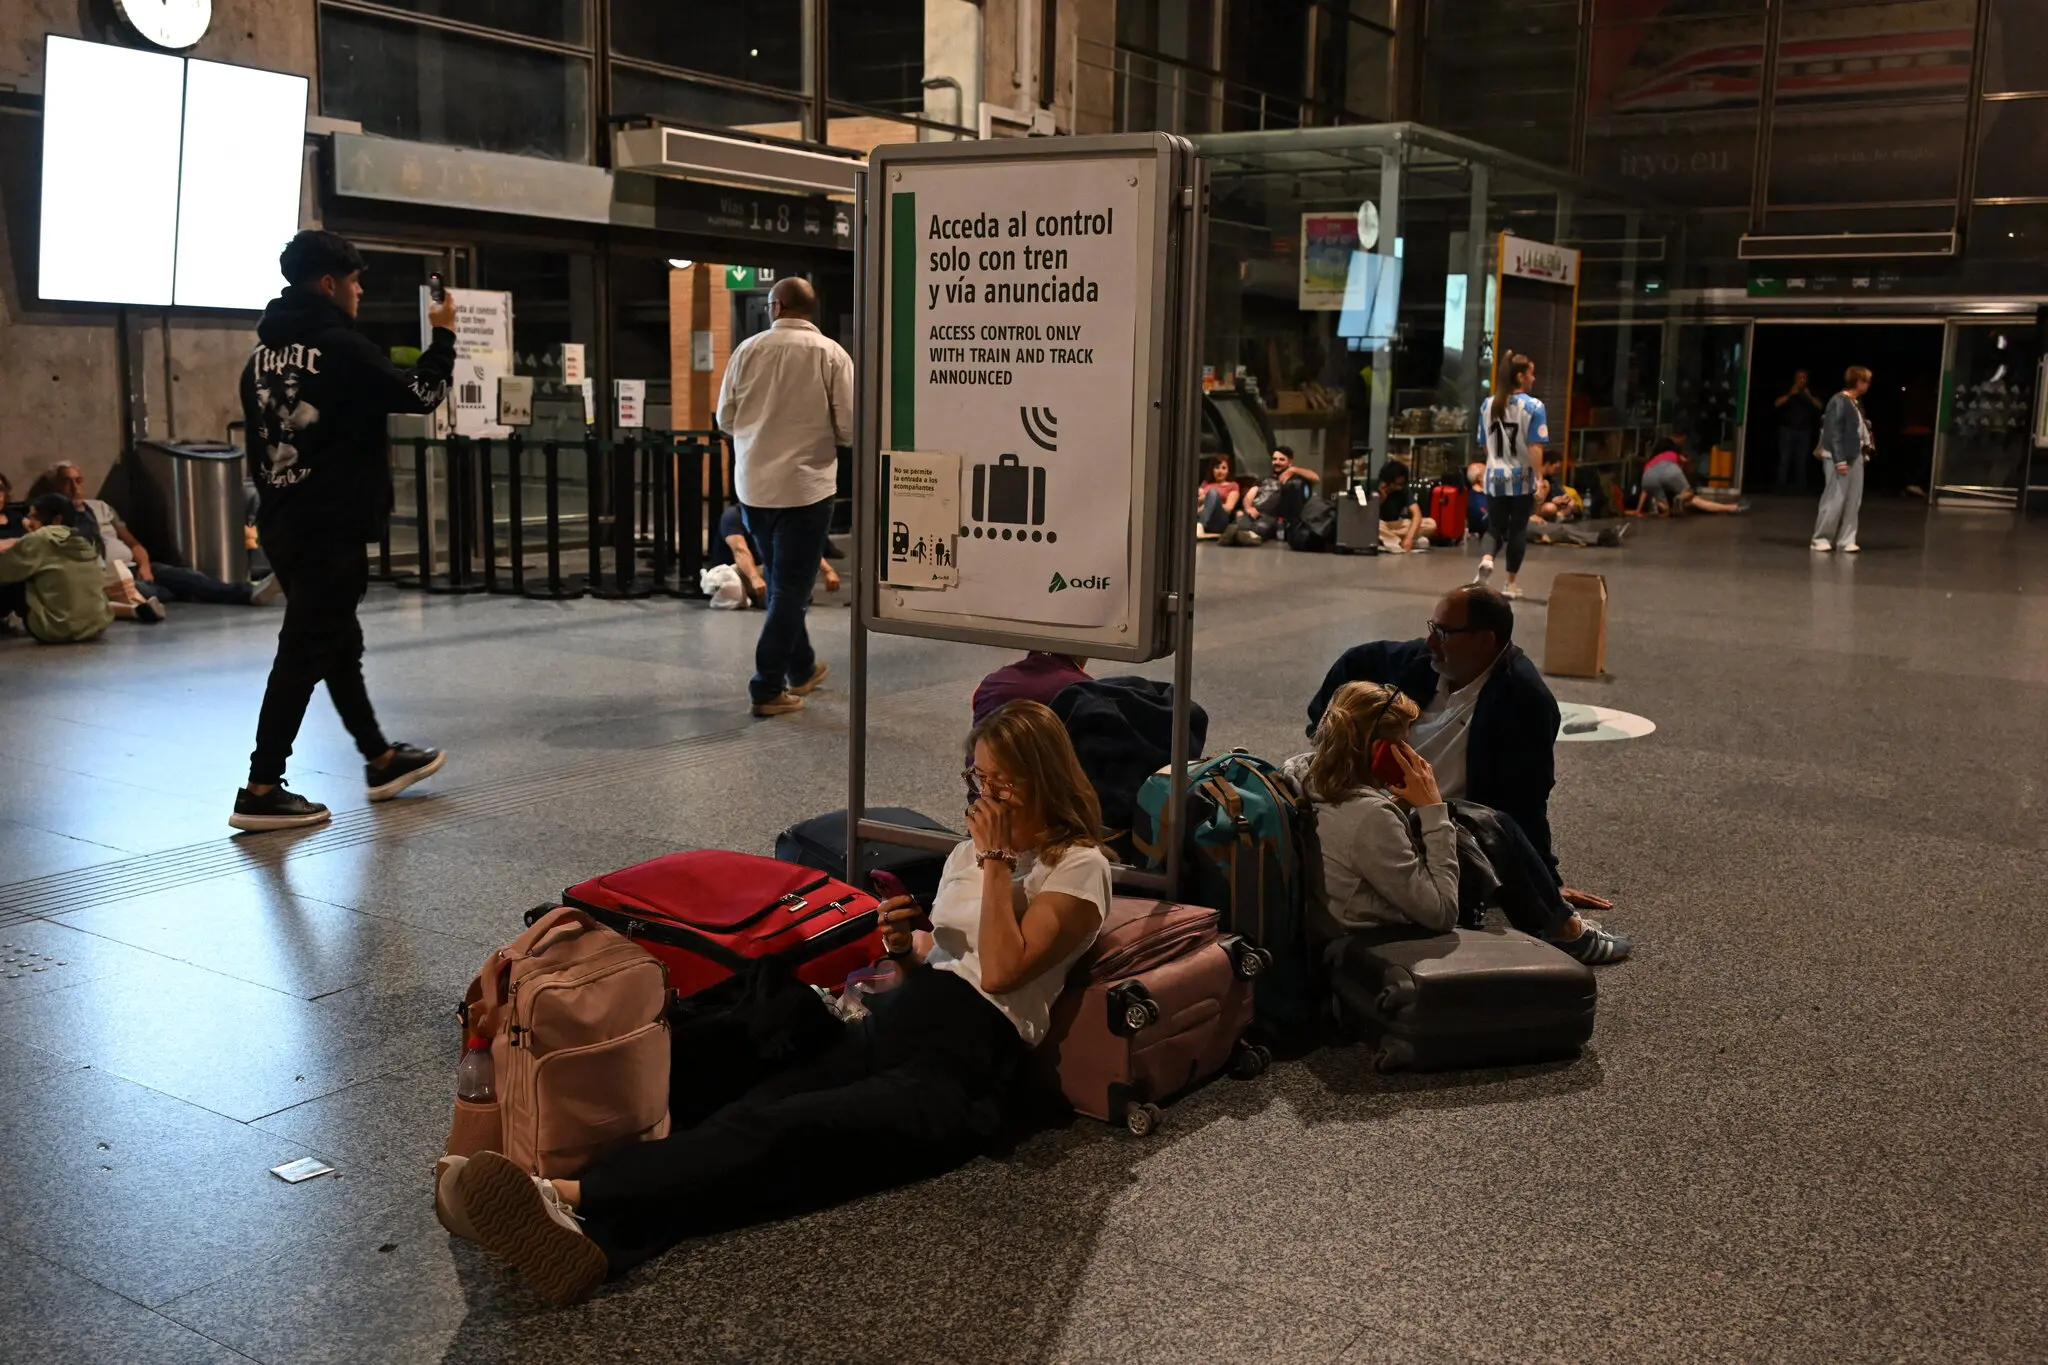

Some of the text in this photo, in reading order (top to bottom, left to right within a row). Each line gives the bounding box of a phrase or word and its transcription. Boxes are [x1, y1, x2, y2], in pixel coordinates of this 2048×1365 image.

[750, 201, 761, 230] 1
[765, 218, 773, 231] a
[777, 204, 790, 233] 8
[929, 207, 1113, 240] Acceda al control
[930, 245, 1068, 272] solo con tren
[928, 274, 1099, 310] y vía anunciada
[929, 325, 1082, 341] ACCESS CONTROL ONLY
[929, 347, 1094, 364] WITH TRAIN AND TRACK
[929, 369, 1013, 386] ANNOUNCED
[1489, 421, 1519, 458] 17
[893, 483, 935, 491] acompañantes
[1070, 575, 1111, 590] adif
